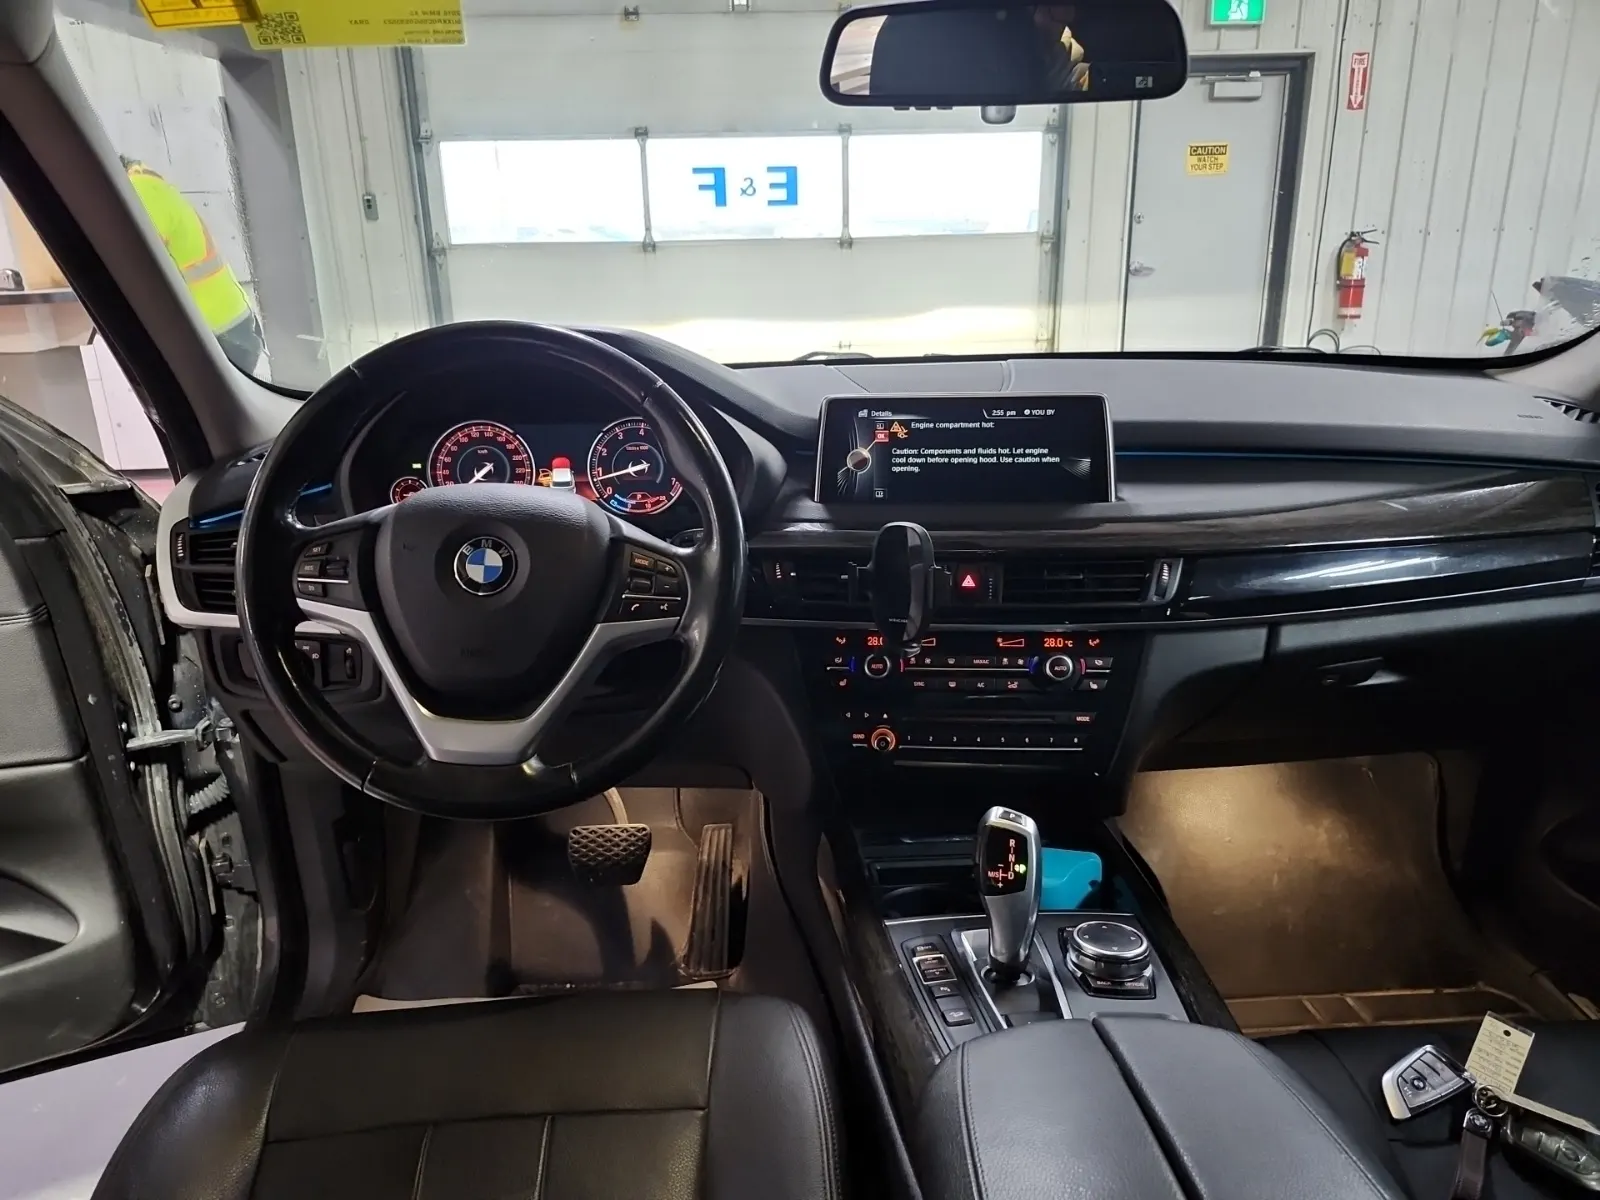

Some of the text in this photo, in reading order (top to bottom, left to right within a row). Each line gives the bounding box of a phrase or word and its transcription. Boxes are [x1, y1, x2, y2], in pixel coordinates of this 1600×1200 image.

[1353, 57, 1367, 66] FIRE
[1191, 146, 1227, 155] CAUTION
[1190, 162, 1224, 171] YOUR STEP
[871, 410, 893, 418] Details
[911, 421, 934, 430] Engine
[935, 422, 981, 430] compartment
[617, 432, 624, 440] 3
[639, 428, 645, 437] 4
[601, 448, 608, 456] 2
[891, 447, 919, 455] Caution:
[919, 447, 962, 456] Components
[962, 447, 977, 455] and
[997, 447, 1012, 455] hot.
[1025, 447, 1049, 455] engine
[949, 456, 978, 465] opening
[891, 465, 921, 473] opening.
[671, 477, 677, 486] 7
[606, 486, 613, 495] 0
[462, 539, 511, 558] BMW
[1043, 638, 1064, 647] 28.0
[1009, 839, 1016, 847] R
[1008, 853, 1016, 862] N
[987, 870, 1000, 878] M/S
[1007, 871, 1015, 880] D
